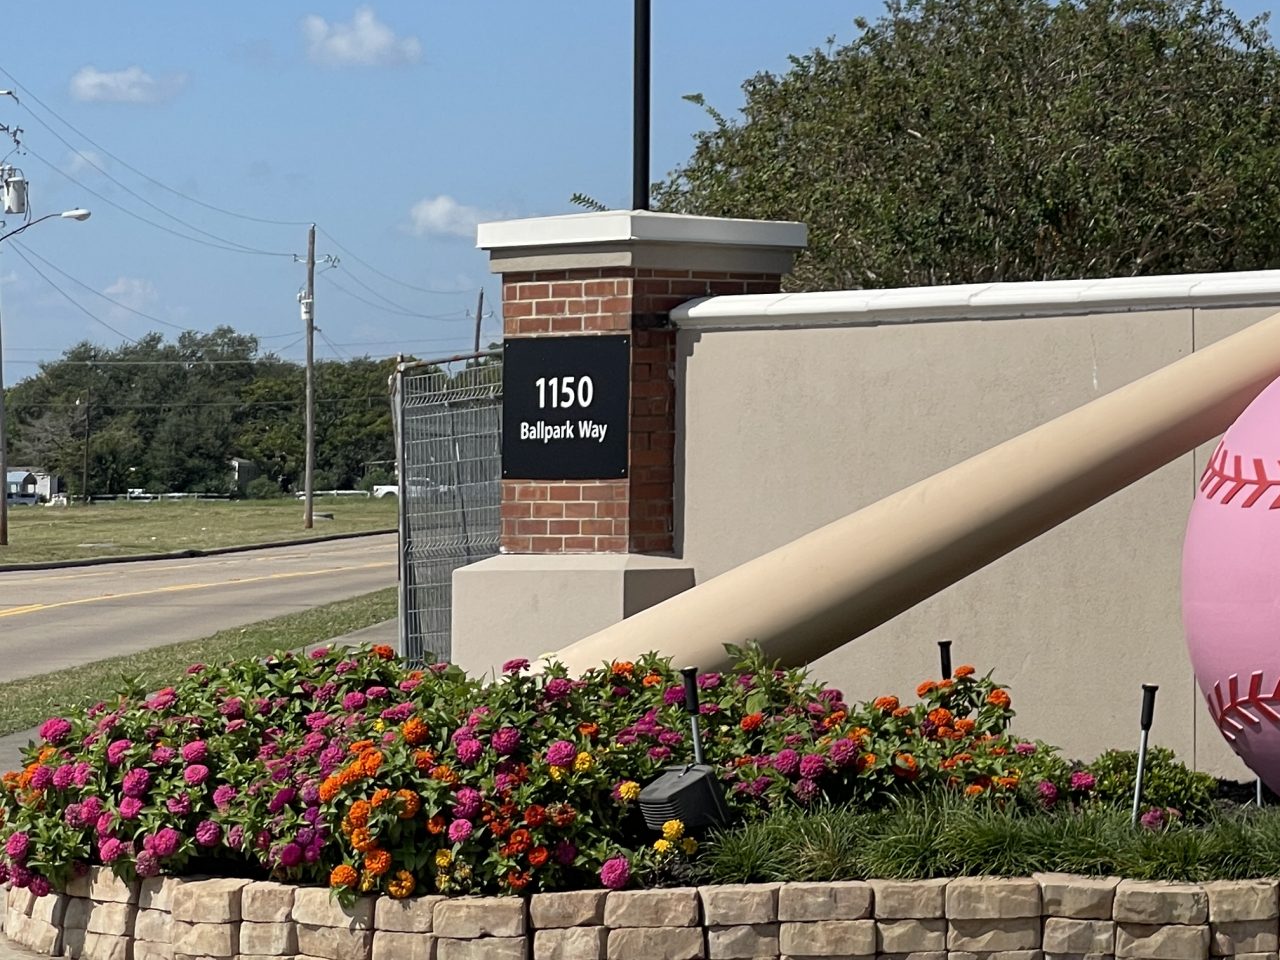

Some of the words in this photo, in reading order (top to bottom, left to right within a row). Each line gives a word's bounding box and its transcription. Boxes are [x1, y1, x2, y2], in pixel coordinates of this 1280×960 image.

[536, 376, 594, 408] 1150
[520, 421, 574, 443] Ballpark
[578, 421, 608, 442] Way
